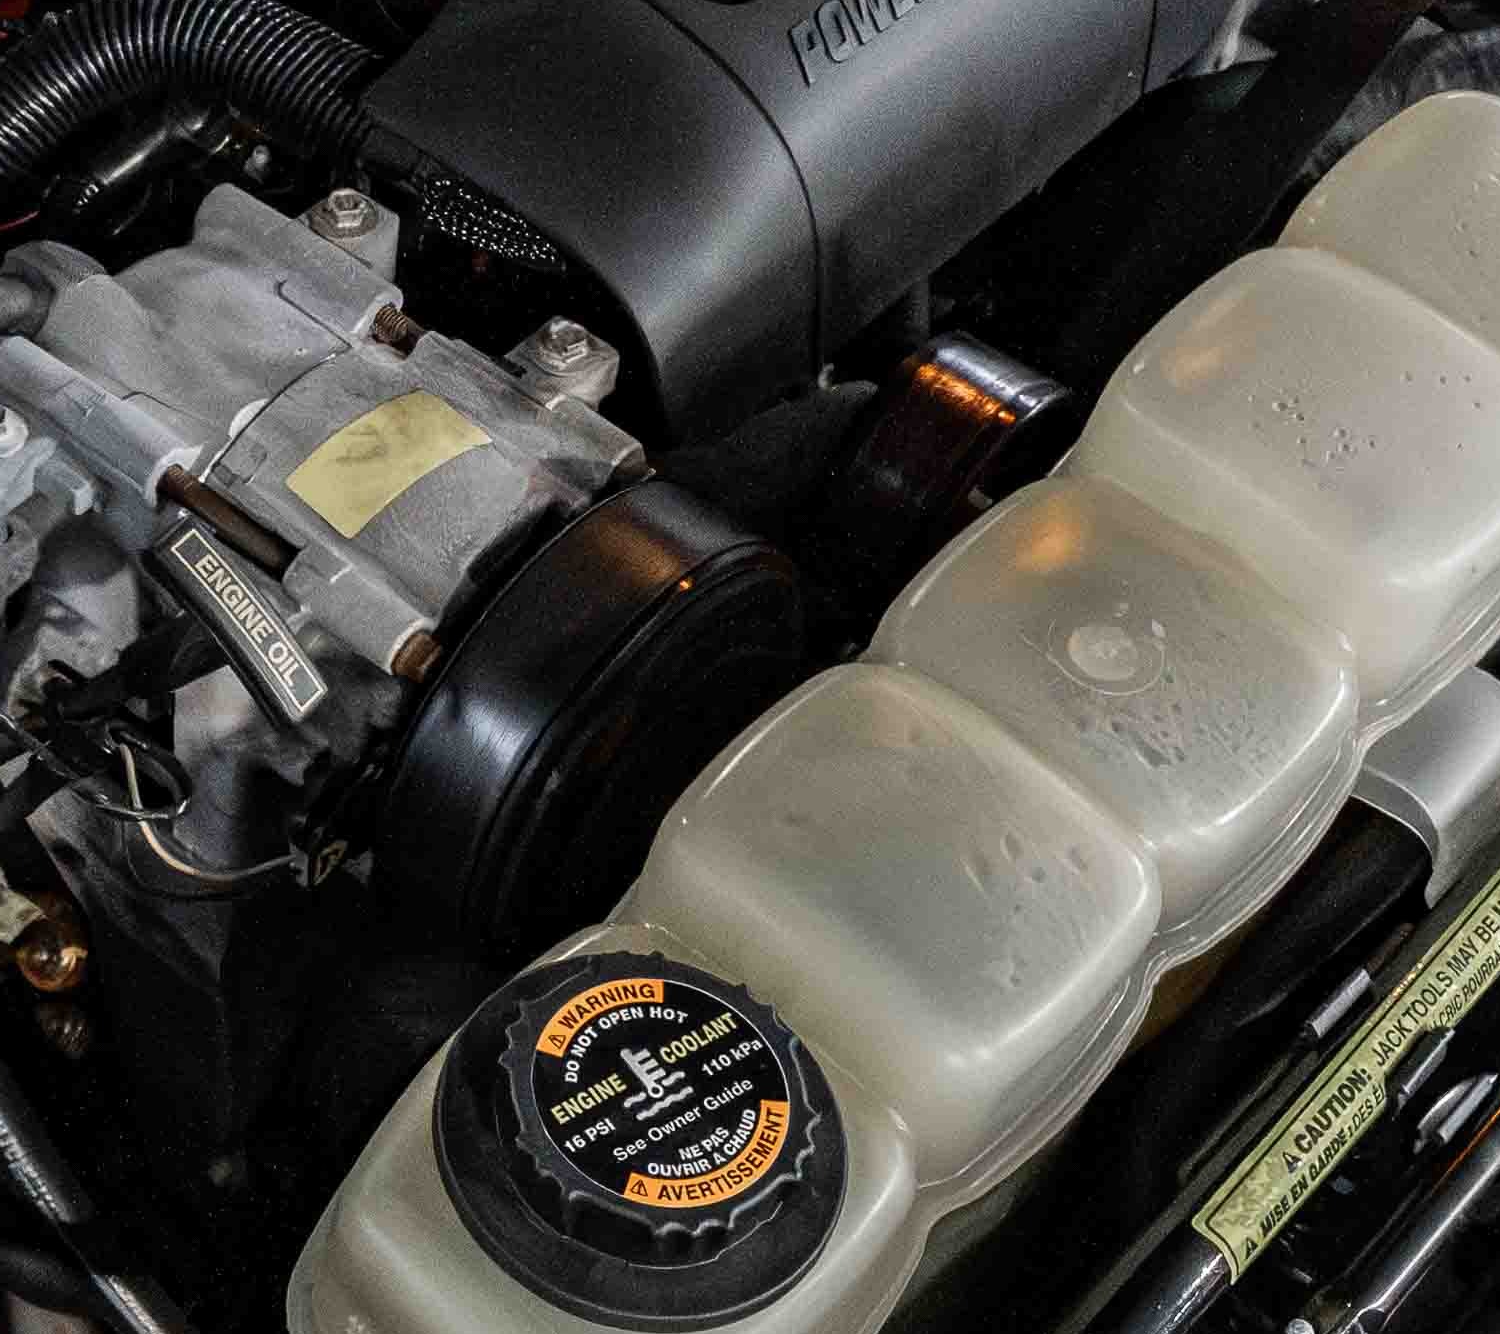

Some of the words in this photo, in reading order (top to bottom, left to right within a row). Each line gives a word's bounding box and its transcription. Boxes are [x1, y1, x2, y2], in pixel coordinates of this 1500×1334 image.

[195, 554, 274, 644] ENGINE
[268, 641, 300, 687] OIL
[558, 983, 656, 1030] WARNING
[564, 1060, 581, 1083] DO
[574, 1028, 599, 1058] NOT
[599, 1006, 644, 1030] OPEN
[649, 1005, 688, 1025] HOT
[1293, 1068, 1372, 1154] CAUTION:
[1371, 1018, 1413, 1067] JACK
[1401, 971, 1453, 1025] TOOLS
[1445, 936, 1479, 977] MAY
[1472, 915, 1500, 944] BE
[550, 1073, 628, 1125] ENGINE
[658, 1012, 736, 1065] COOLANT
[563, 1134, 586, 1155] 16
[587, 1117, 617, 1143] PSI
[701, 1053, 732, 1078] 110
[734, 1039, 764, 1062] kPa
[613, 1139, 648, 1163] See
[648, 1106, 702, 1143] Owner
[703, 1078, 754, 1112] Guide
[647, 1157, 712, 1178] OUVRIR
[723, 1109, 758, 1156] CHAUD
[657, 1107, 786, 1201] AVERTISSEMENT
[678, 1144, 701, 1162] NE
[700, 1127, 730, 1152] PAS
[1260, 1195, 1291, 1237] MISE
[1290, 1173, 1309, 1202] EN
